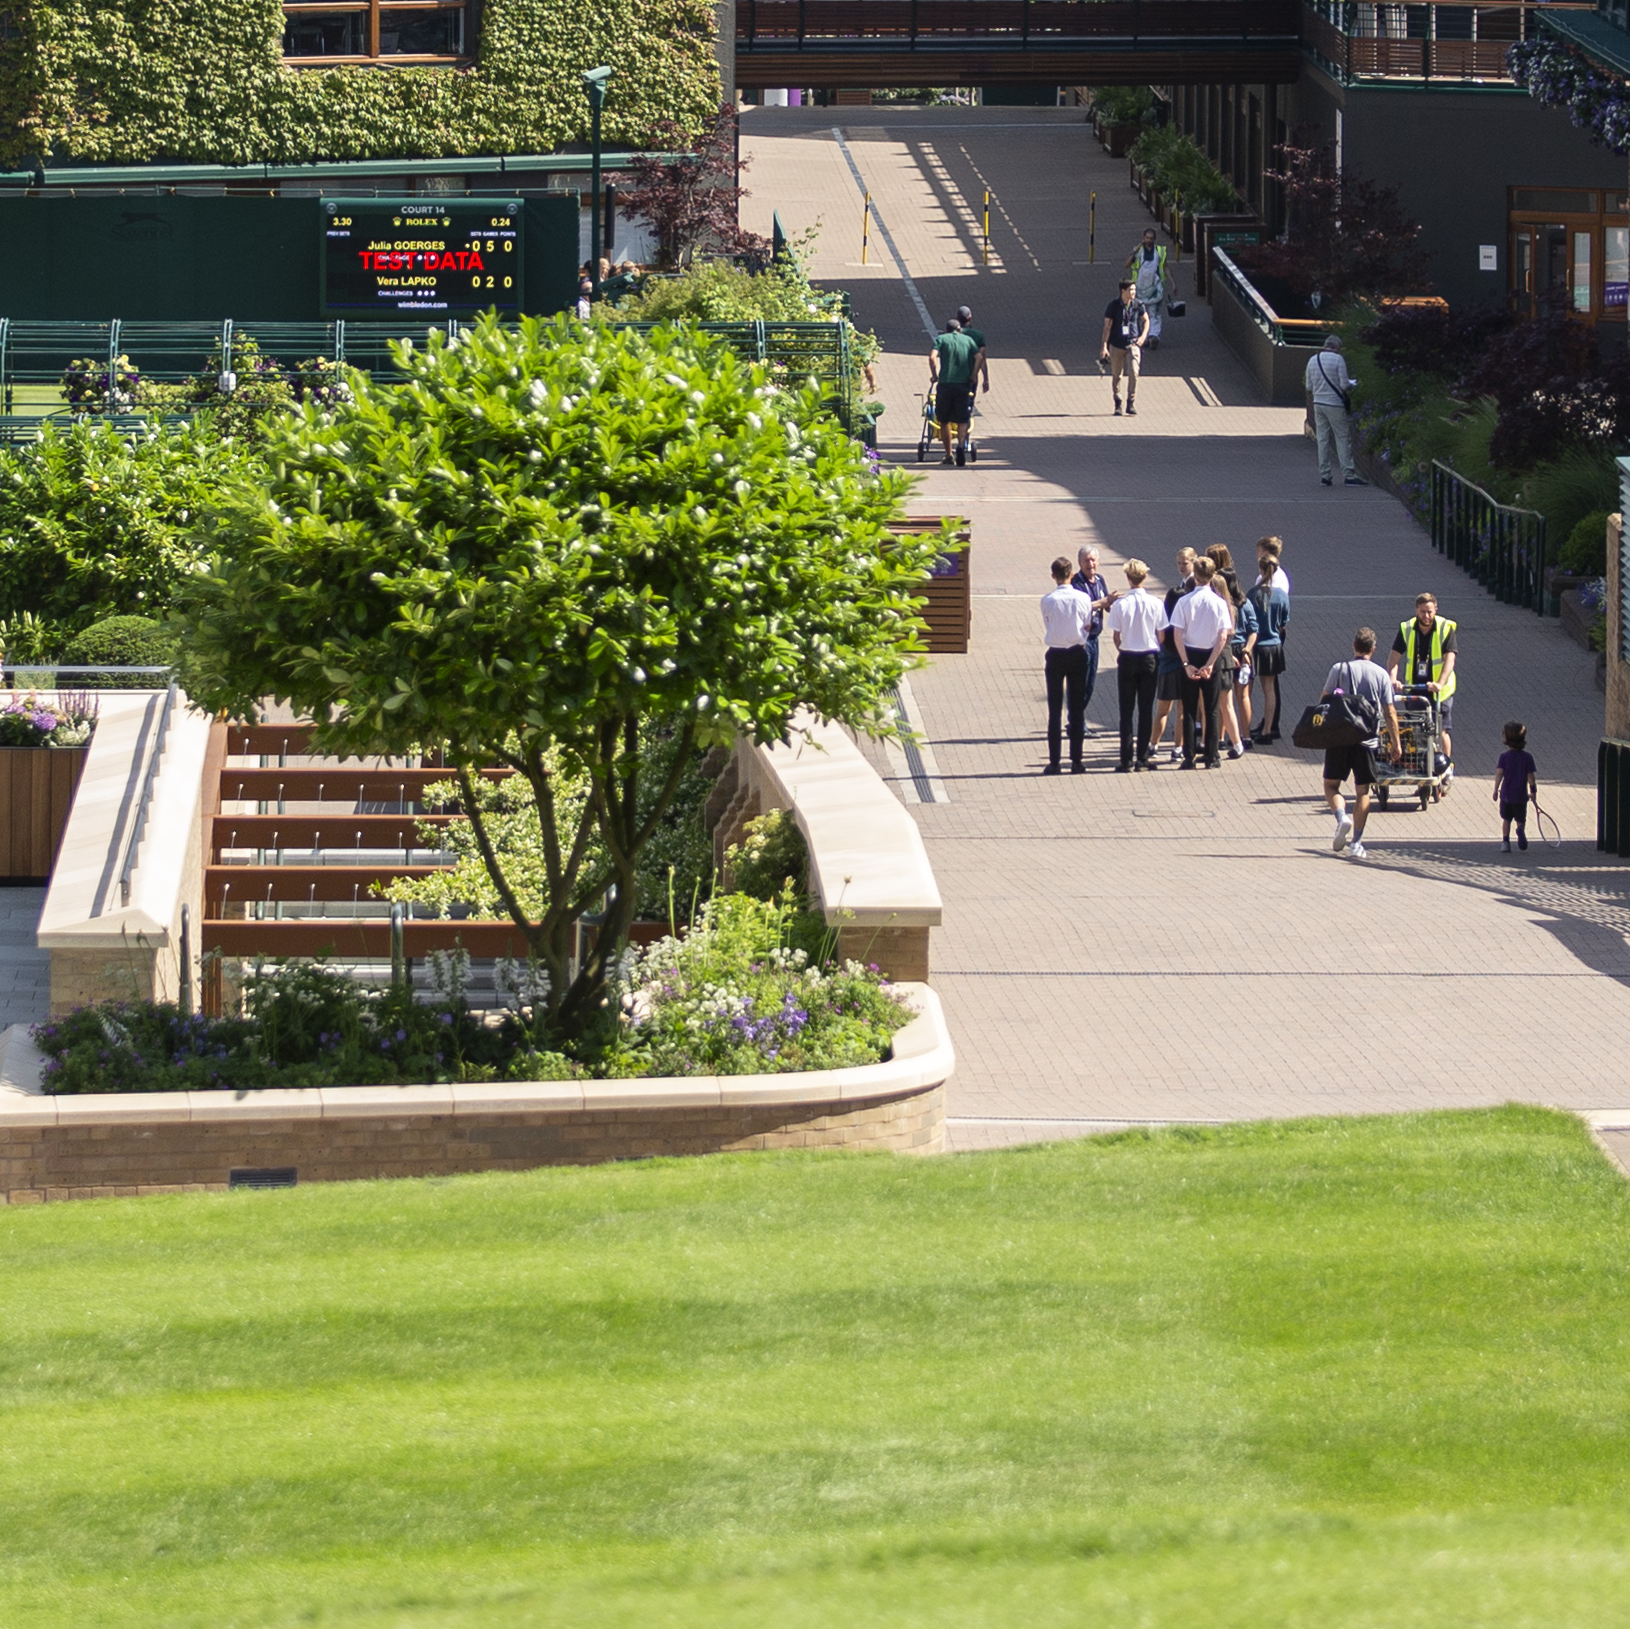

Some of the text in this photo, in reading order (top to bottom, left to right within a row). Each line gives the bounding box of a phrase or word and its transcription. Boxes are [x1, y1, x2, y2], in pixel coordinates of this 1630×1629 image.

[401, 206, 445, 214] COURT 14
[333, 217, 352, 226] 3.30
[406, 218, 438, 226] ROLEX
[491, 217, 511, 227] 0.24
[367, 240, 513, 252] Julia GOERGES 0 5 0
[358, 251, 484, 270] TEST DATA
[377, 276, 512, 288] Vera LAPKO 0 2 0
[397, 301, 448, 309] wimbledon.com
